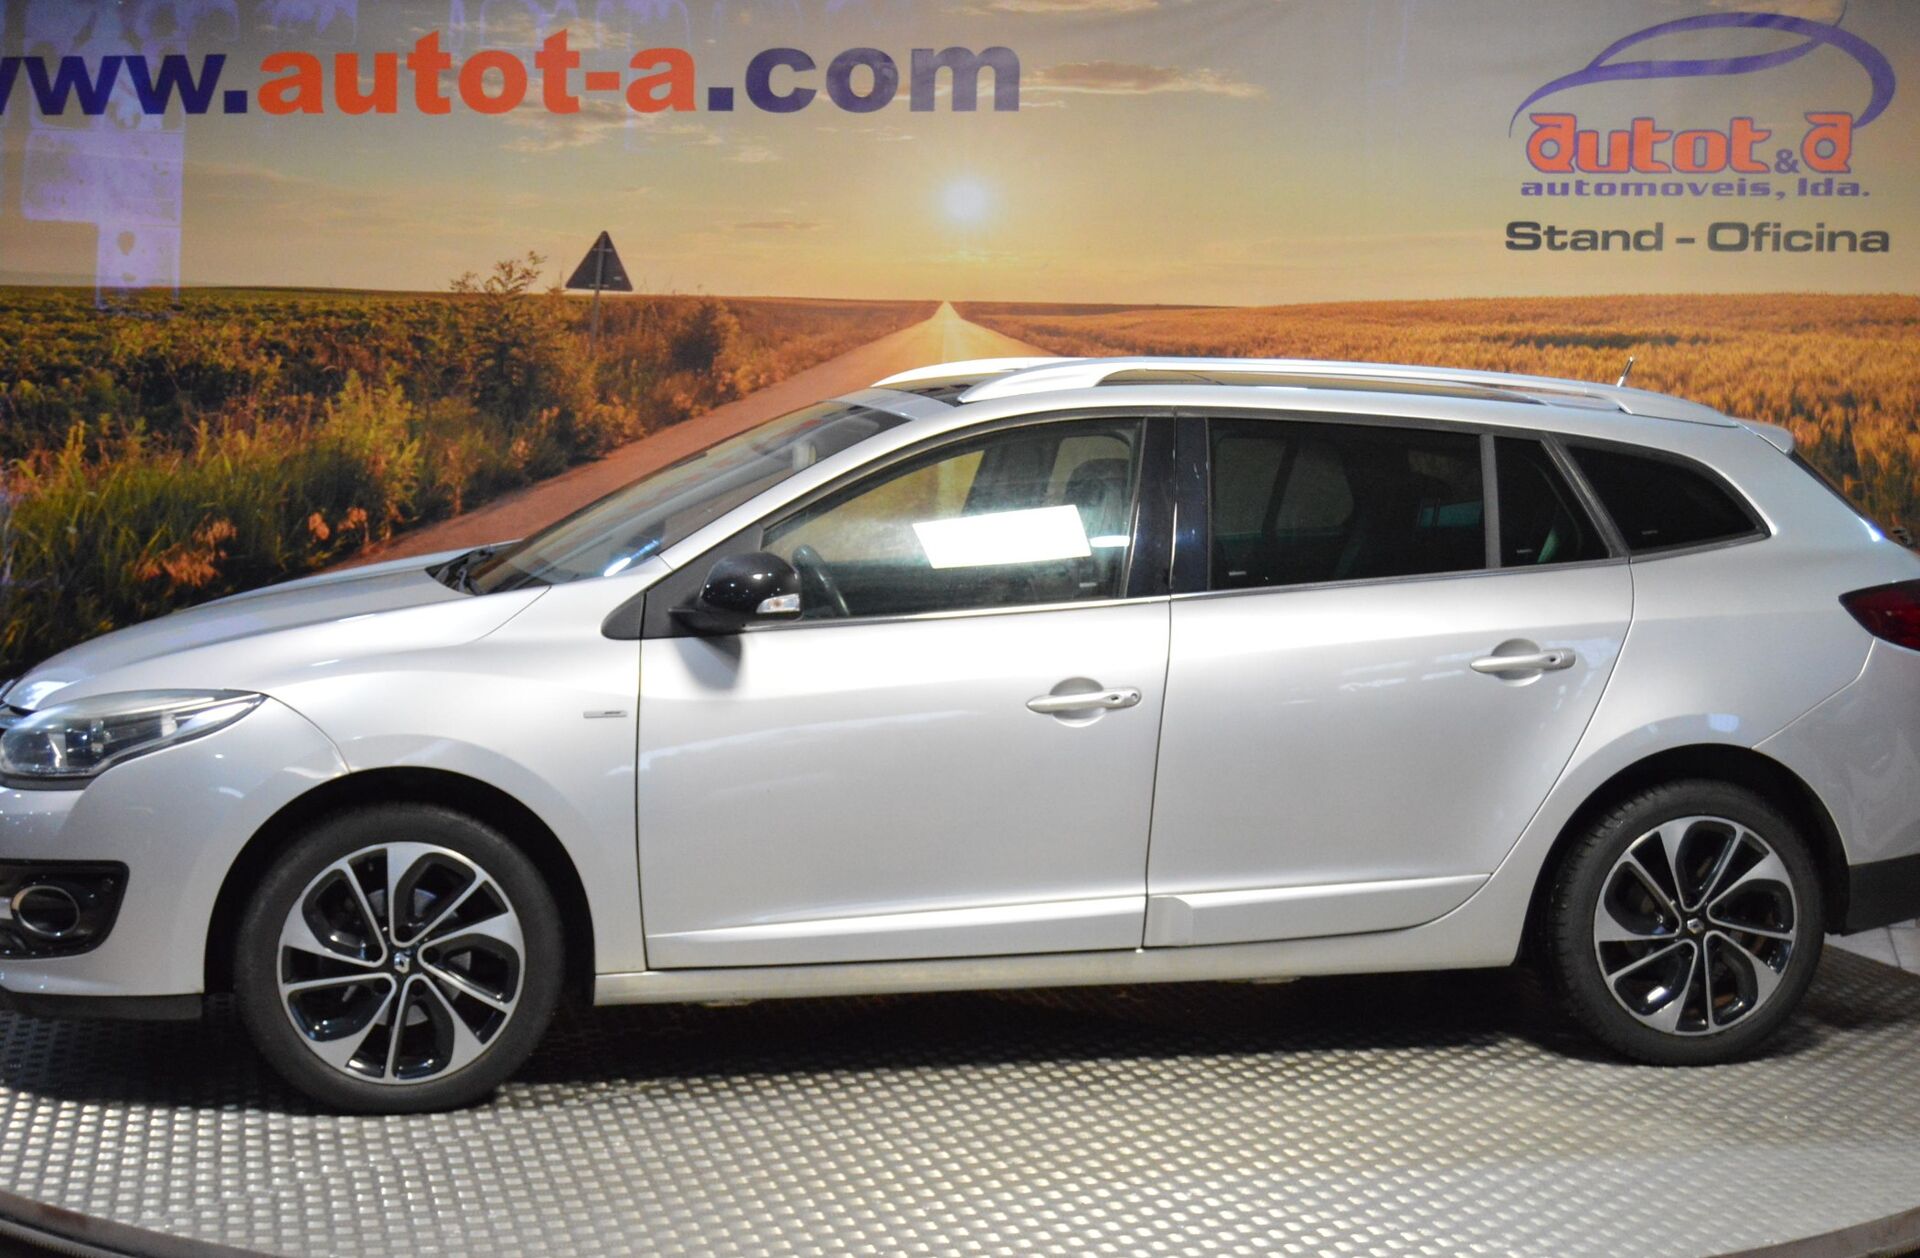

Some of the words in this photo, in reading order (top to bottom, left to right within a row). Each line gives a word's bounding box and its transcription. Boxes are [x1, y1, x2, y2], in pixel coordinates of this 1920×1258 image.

[0, 29, 1020, 114] ww.autot-a.com
[1521, 178, 1786, 200] automoveis,
[1797, 177, 1870, 196] lda.
[1505, 221, 1664, 251] Stand
[1707, 221, 1890, 252] Oficina
